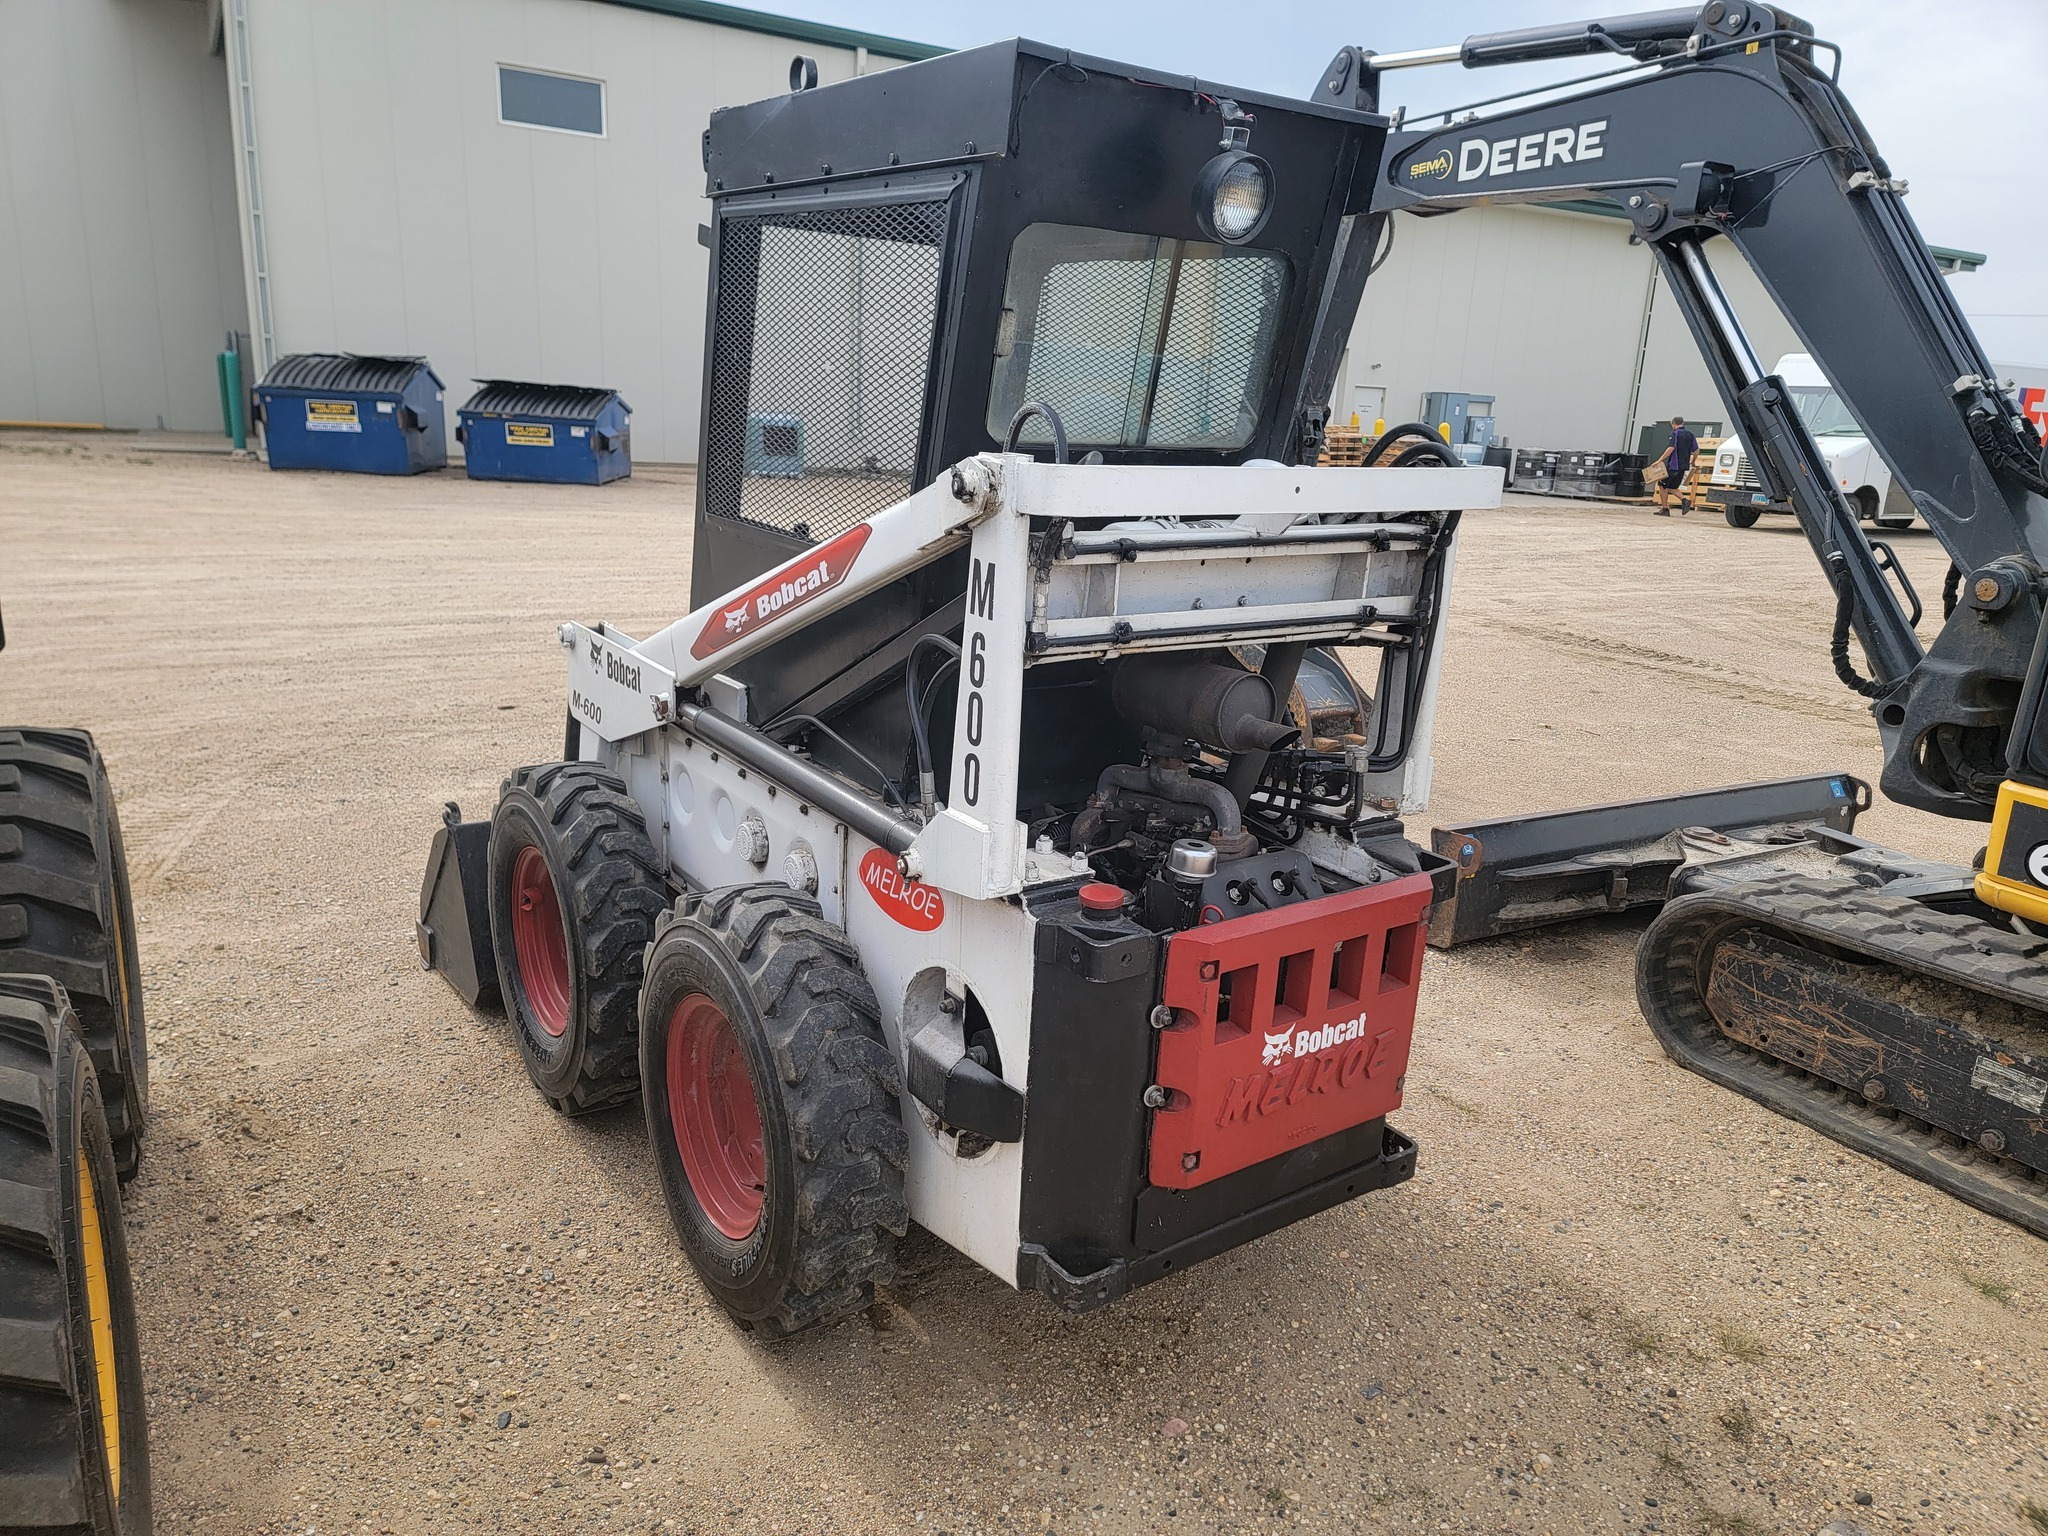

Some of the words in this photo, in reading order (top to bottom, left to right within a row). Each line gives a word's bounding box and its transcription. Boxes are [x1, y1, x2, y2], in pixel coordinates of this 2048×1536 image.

[1410, 156, 1447, 176] SEMA
[1457, 120, 1607, 182] DEERE
[756, 560, 830, 619] Bobcat
[606, 650, 642, 694] Bobcat
[572, 689, 602, 724] M-600
[865, 862, 940, 920] MELROE
[1294, 1012, 1367, 1058] Bobcat
[1215, 1026, 1397, 1128] MELROE
